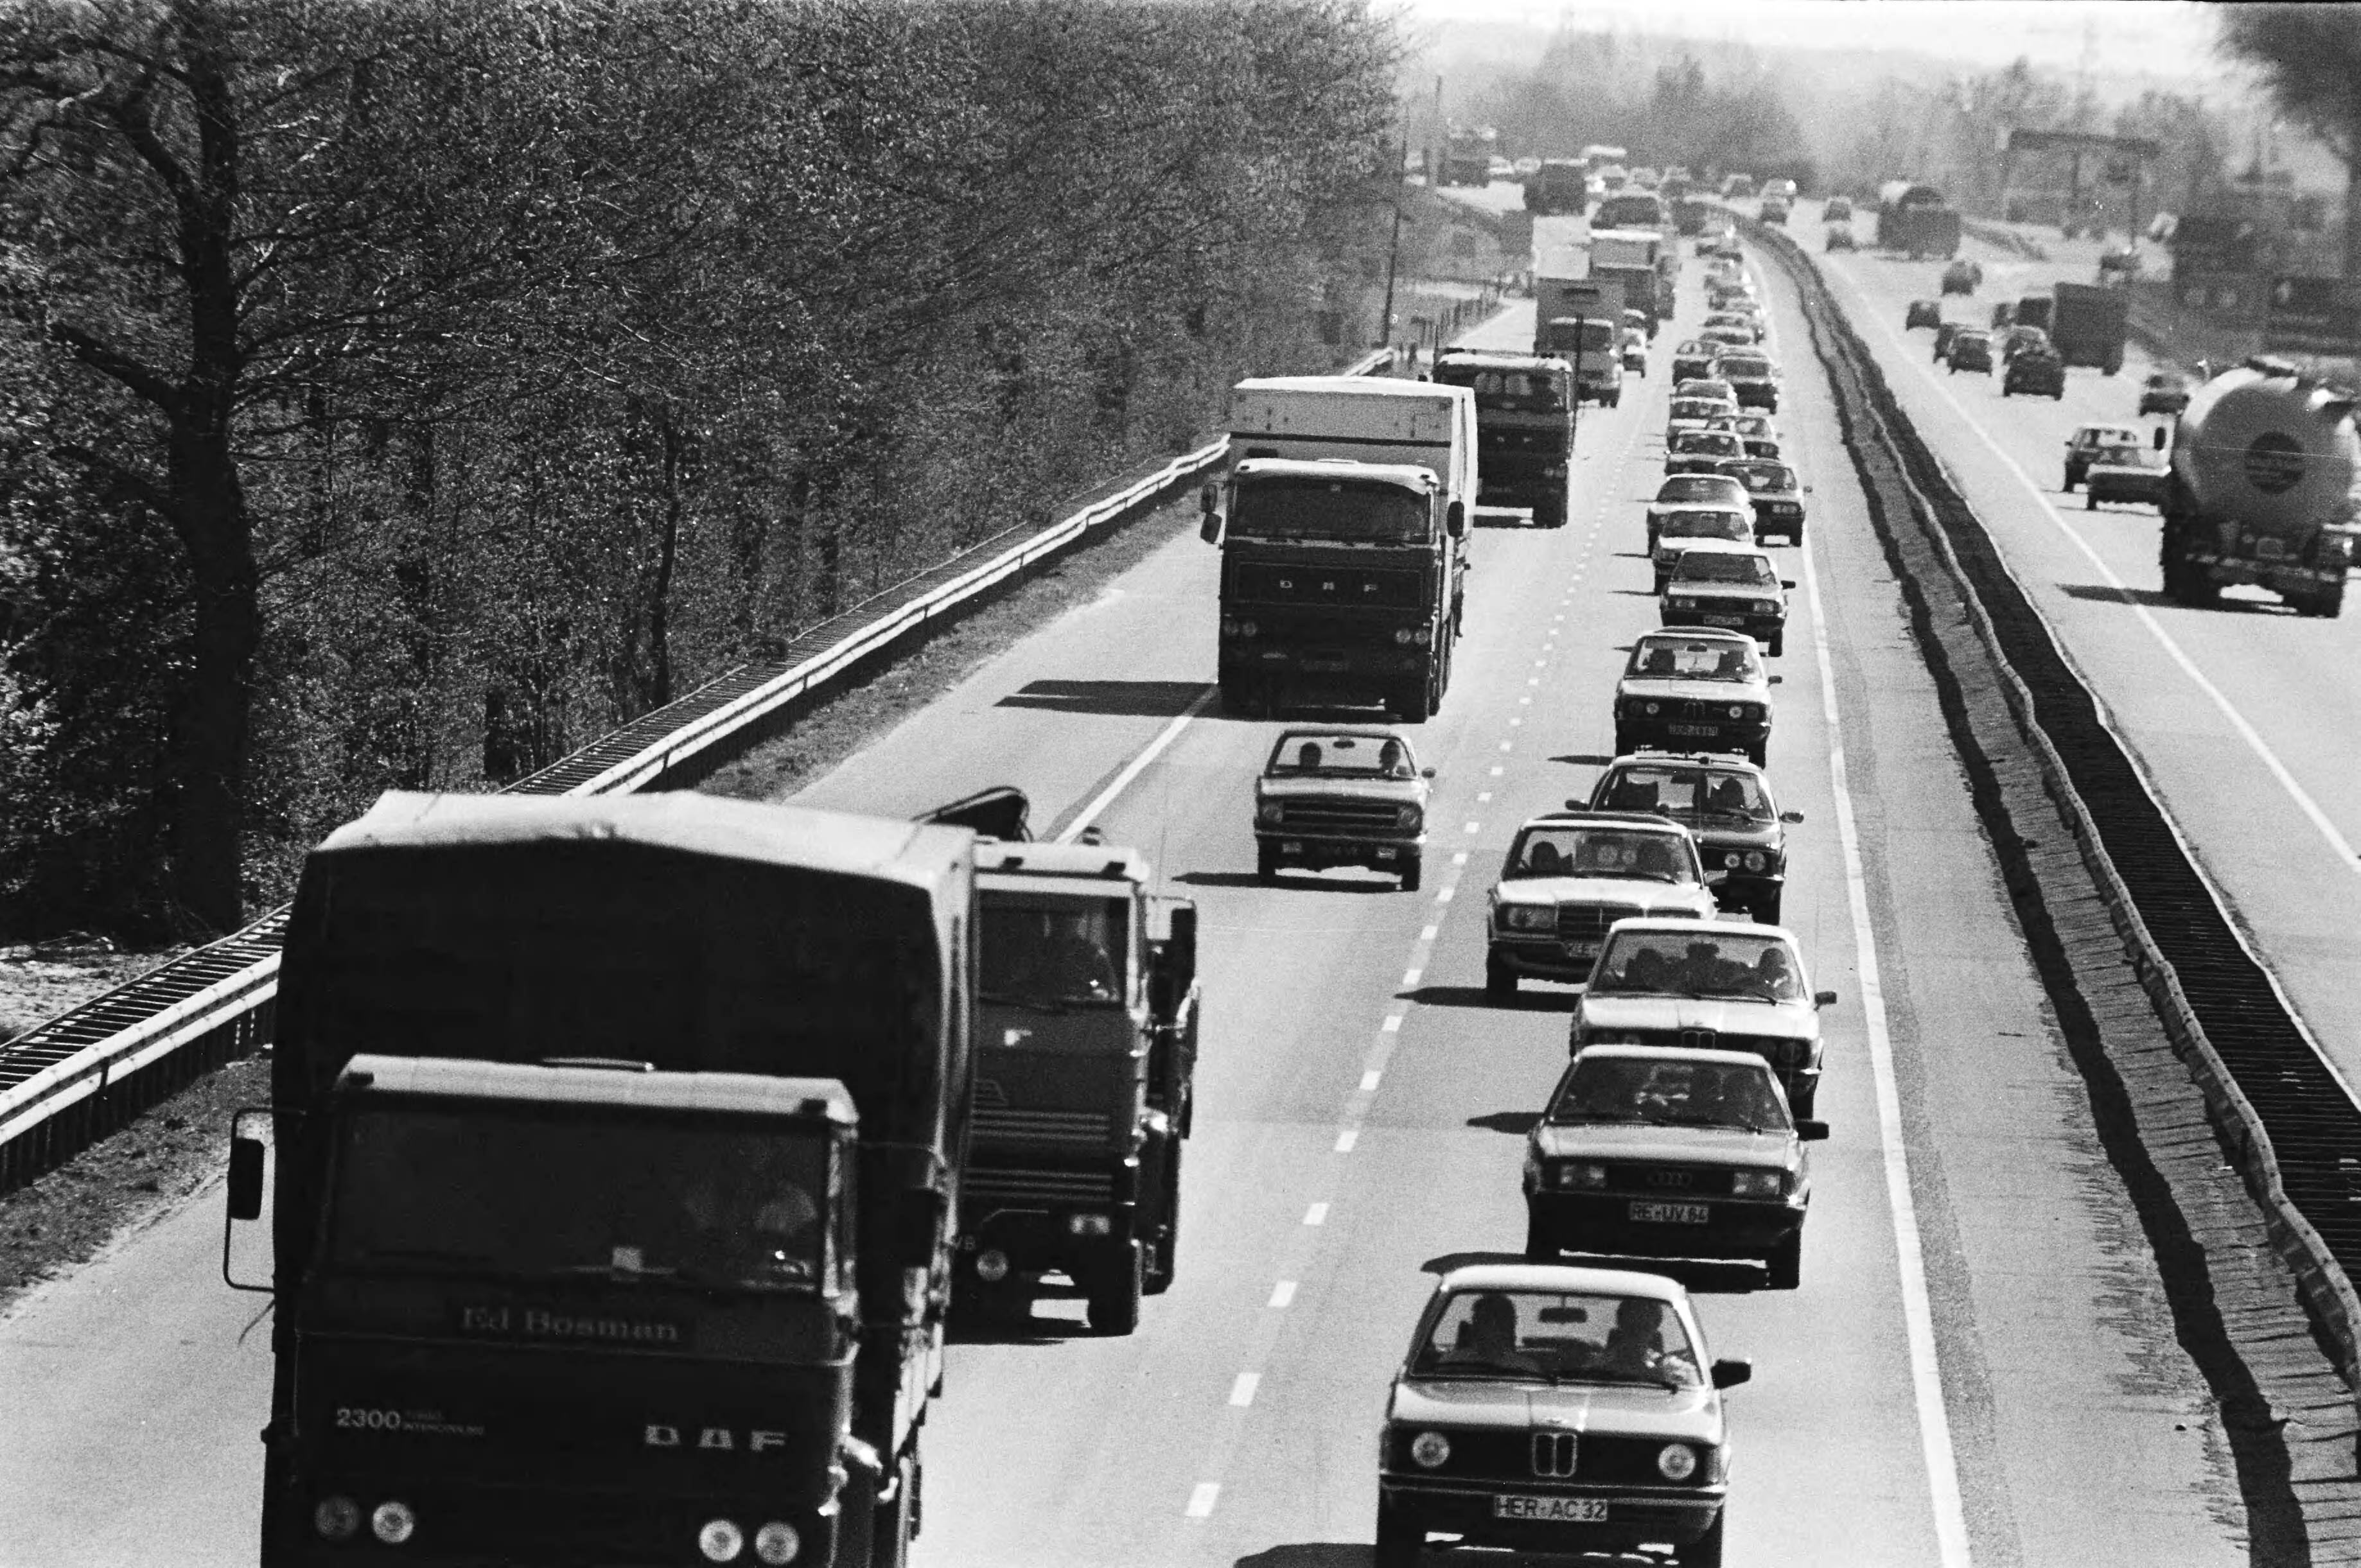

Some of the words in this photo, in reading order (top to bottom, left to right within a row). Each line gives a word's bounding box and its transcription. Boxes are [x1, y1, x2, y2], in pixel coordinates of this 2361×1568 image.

[525, 1310, 678, 1343] Bosman
[337, 1408, 400, 1429] 2300
[644, 1425, 786, 1451] DAF
